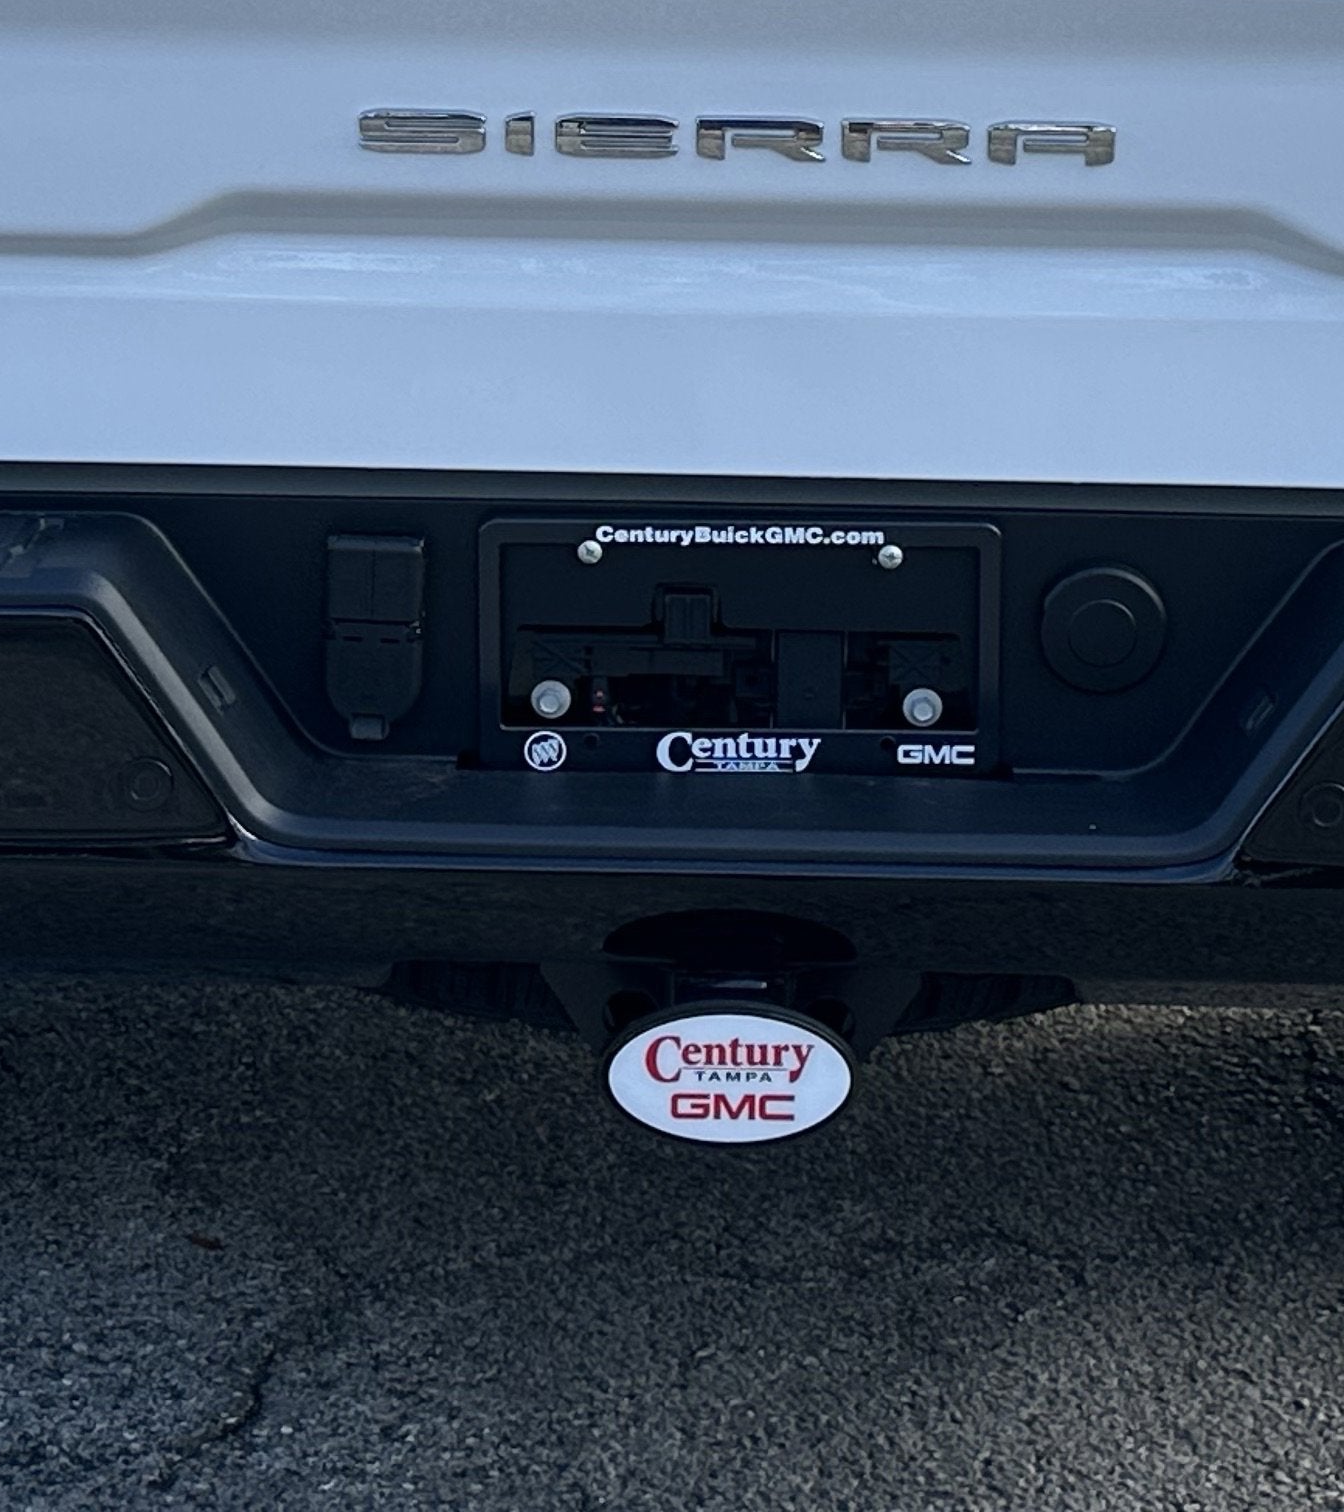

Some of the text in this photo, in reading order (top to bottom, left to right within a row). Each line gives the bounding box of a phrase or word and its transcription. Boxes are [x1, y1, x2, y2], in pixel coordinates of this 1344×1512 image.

[358, 108, 1117, 167] SIERRA
[595, 525, 885, 546] CenturyBuickGMC.com
[656, 731, 823, 773] Century
[897, 744, 976, 765] GMC
[645, 1035, 814, 1083] Century
[695, 1071, 773, 1083] TAMPA
[670, 1093, 796, 1121] GMC
